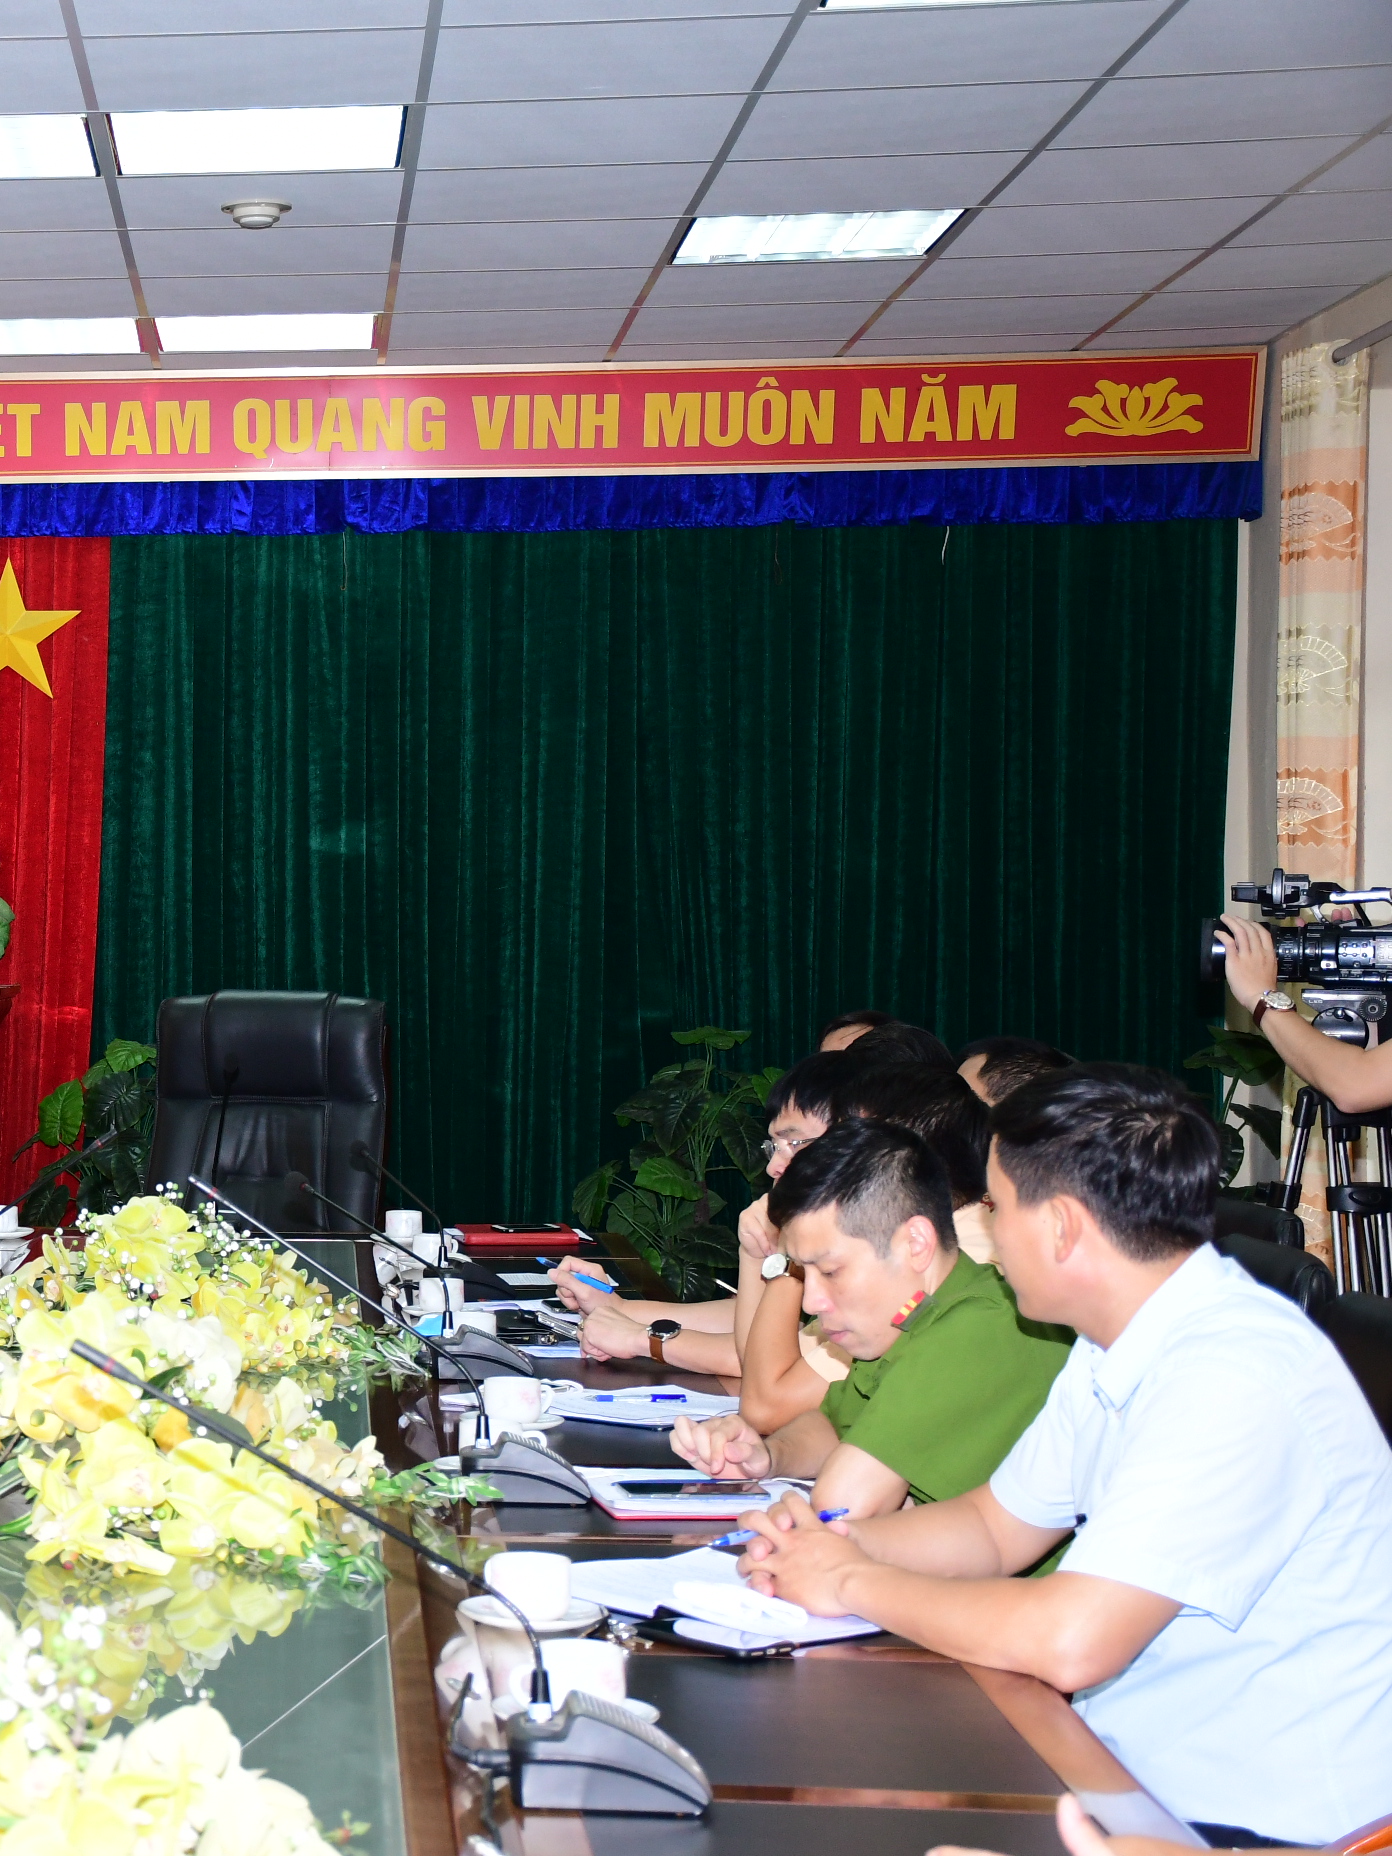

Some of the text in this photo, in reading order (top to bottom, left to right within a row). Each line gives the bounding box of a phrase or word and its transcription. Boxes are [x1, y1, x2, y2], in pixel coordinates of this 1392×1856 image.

[65, 400, 211, 456] NAM
[234, 397, 446, 459] QUANG
[473, 394, 620, 450] VINH
[644, 377, 835, 447] MUÔN
[859, 375, 1016, 443] NĂM
